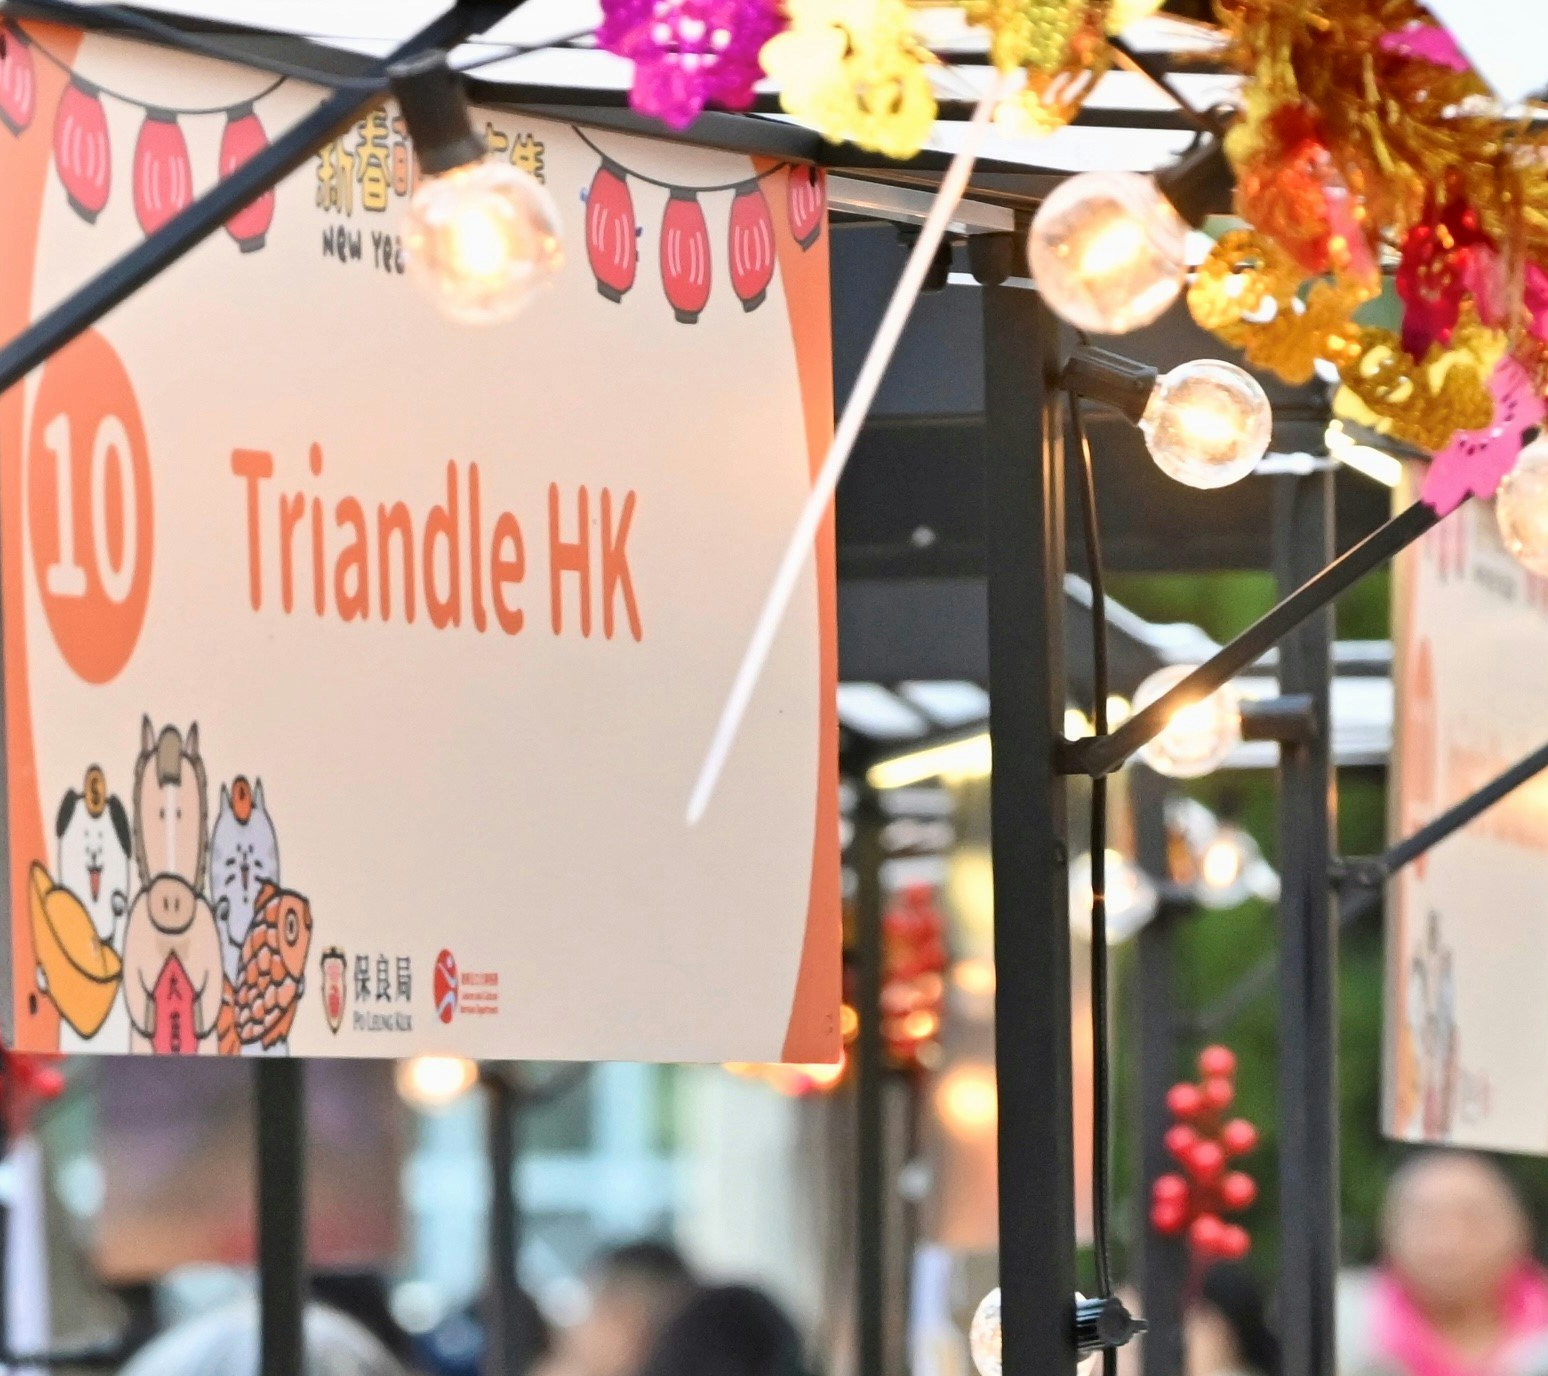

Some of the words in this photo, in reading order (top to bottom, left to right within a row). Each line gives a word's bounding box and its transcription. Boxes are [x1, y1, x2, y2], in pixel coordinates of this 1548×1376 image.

[44, 412, 137, 604] 10
[231, 440, 525, 636] Triandle
[549, 481, 642, 643] HK
[355, 953, 412, 1002] 保良局
